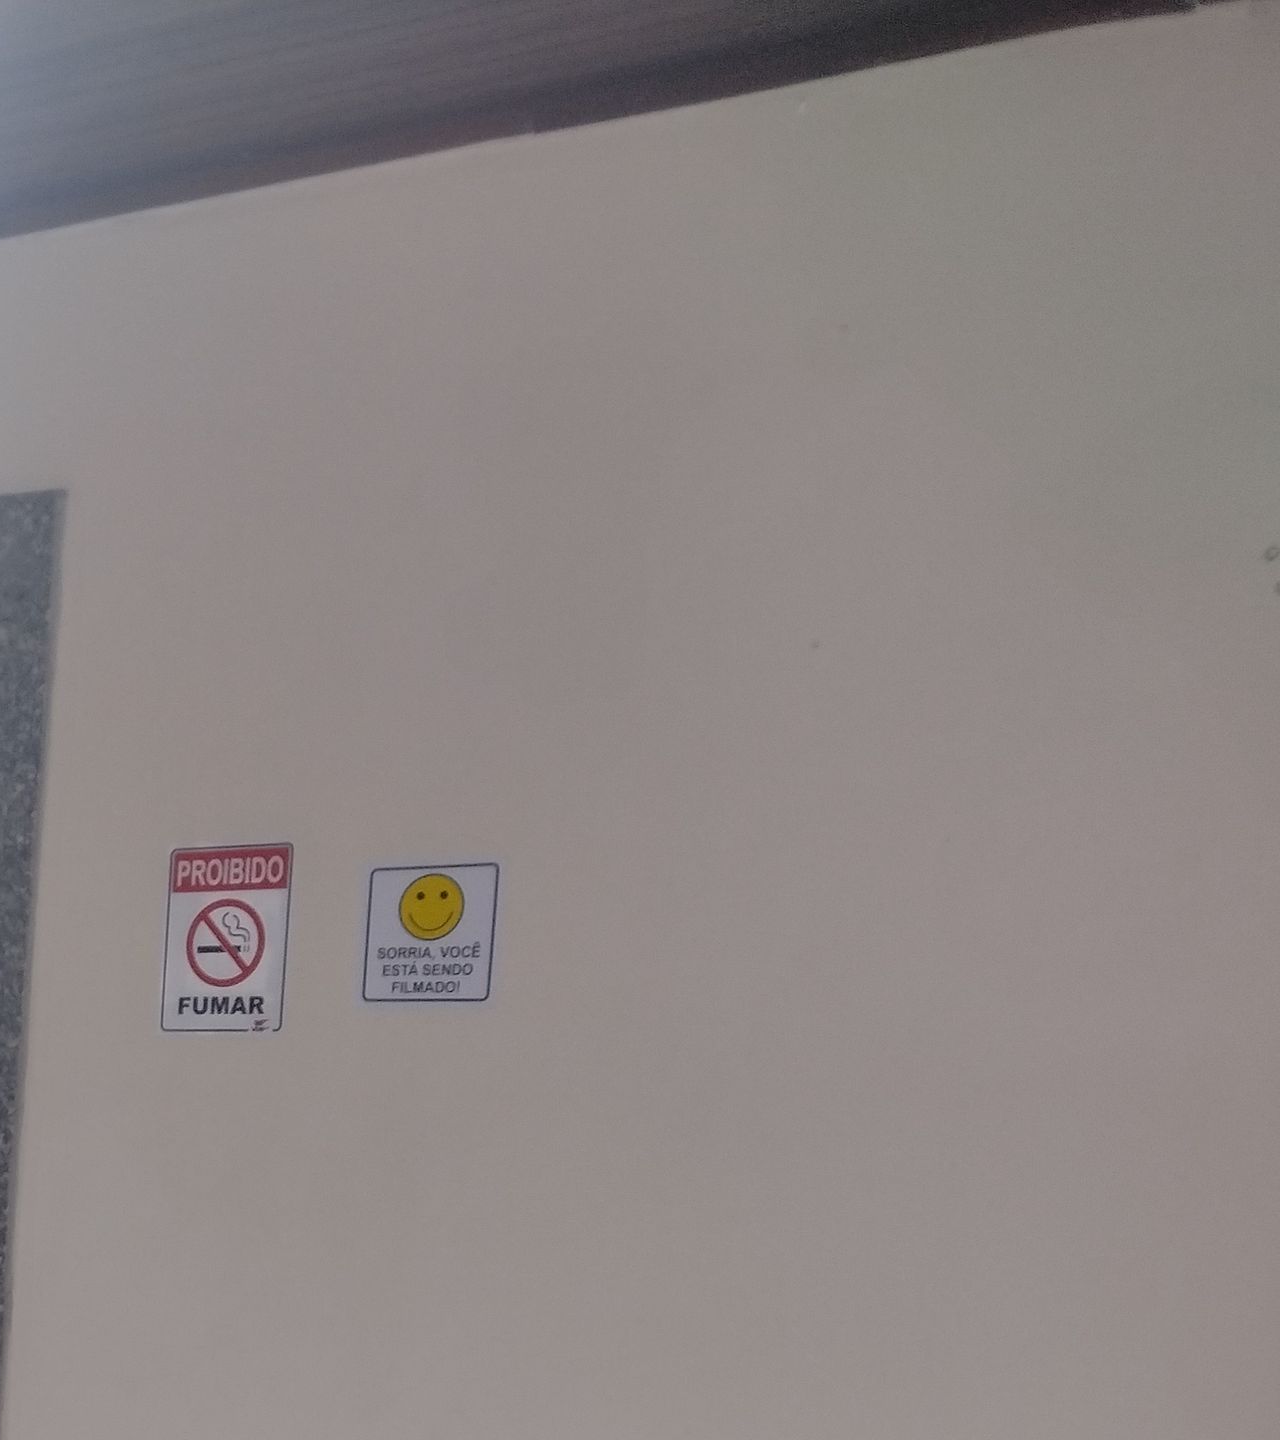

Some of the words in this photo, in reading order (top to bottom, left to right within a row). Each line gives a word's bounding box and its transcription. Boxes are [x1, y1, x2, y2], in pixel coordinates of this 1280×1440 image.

[176, 855, 285, 888] PROIBIDO
[377, 946, 435, 960] SORRIA,
[440, 941, 481, 958] VOCÊ
[382, 961, 418, 976] ESTÁ
[422, 963, 473, 976] SENDO
[391, 980, 461, 994] FILMADO!
[178, 996, 265, 1015] FUMAR
